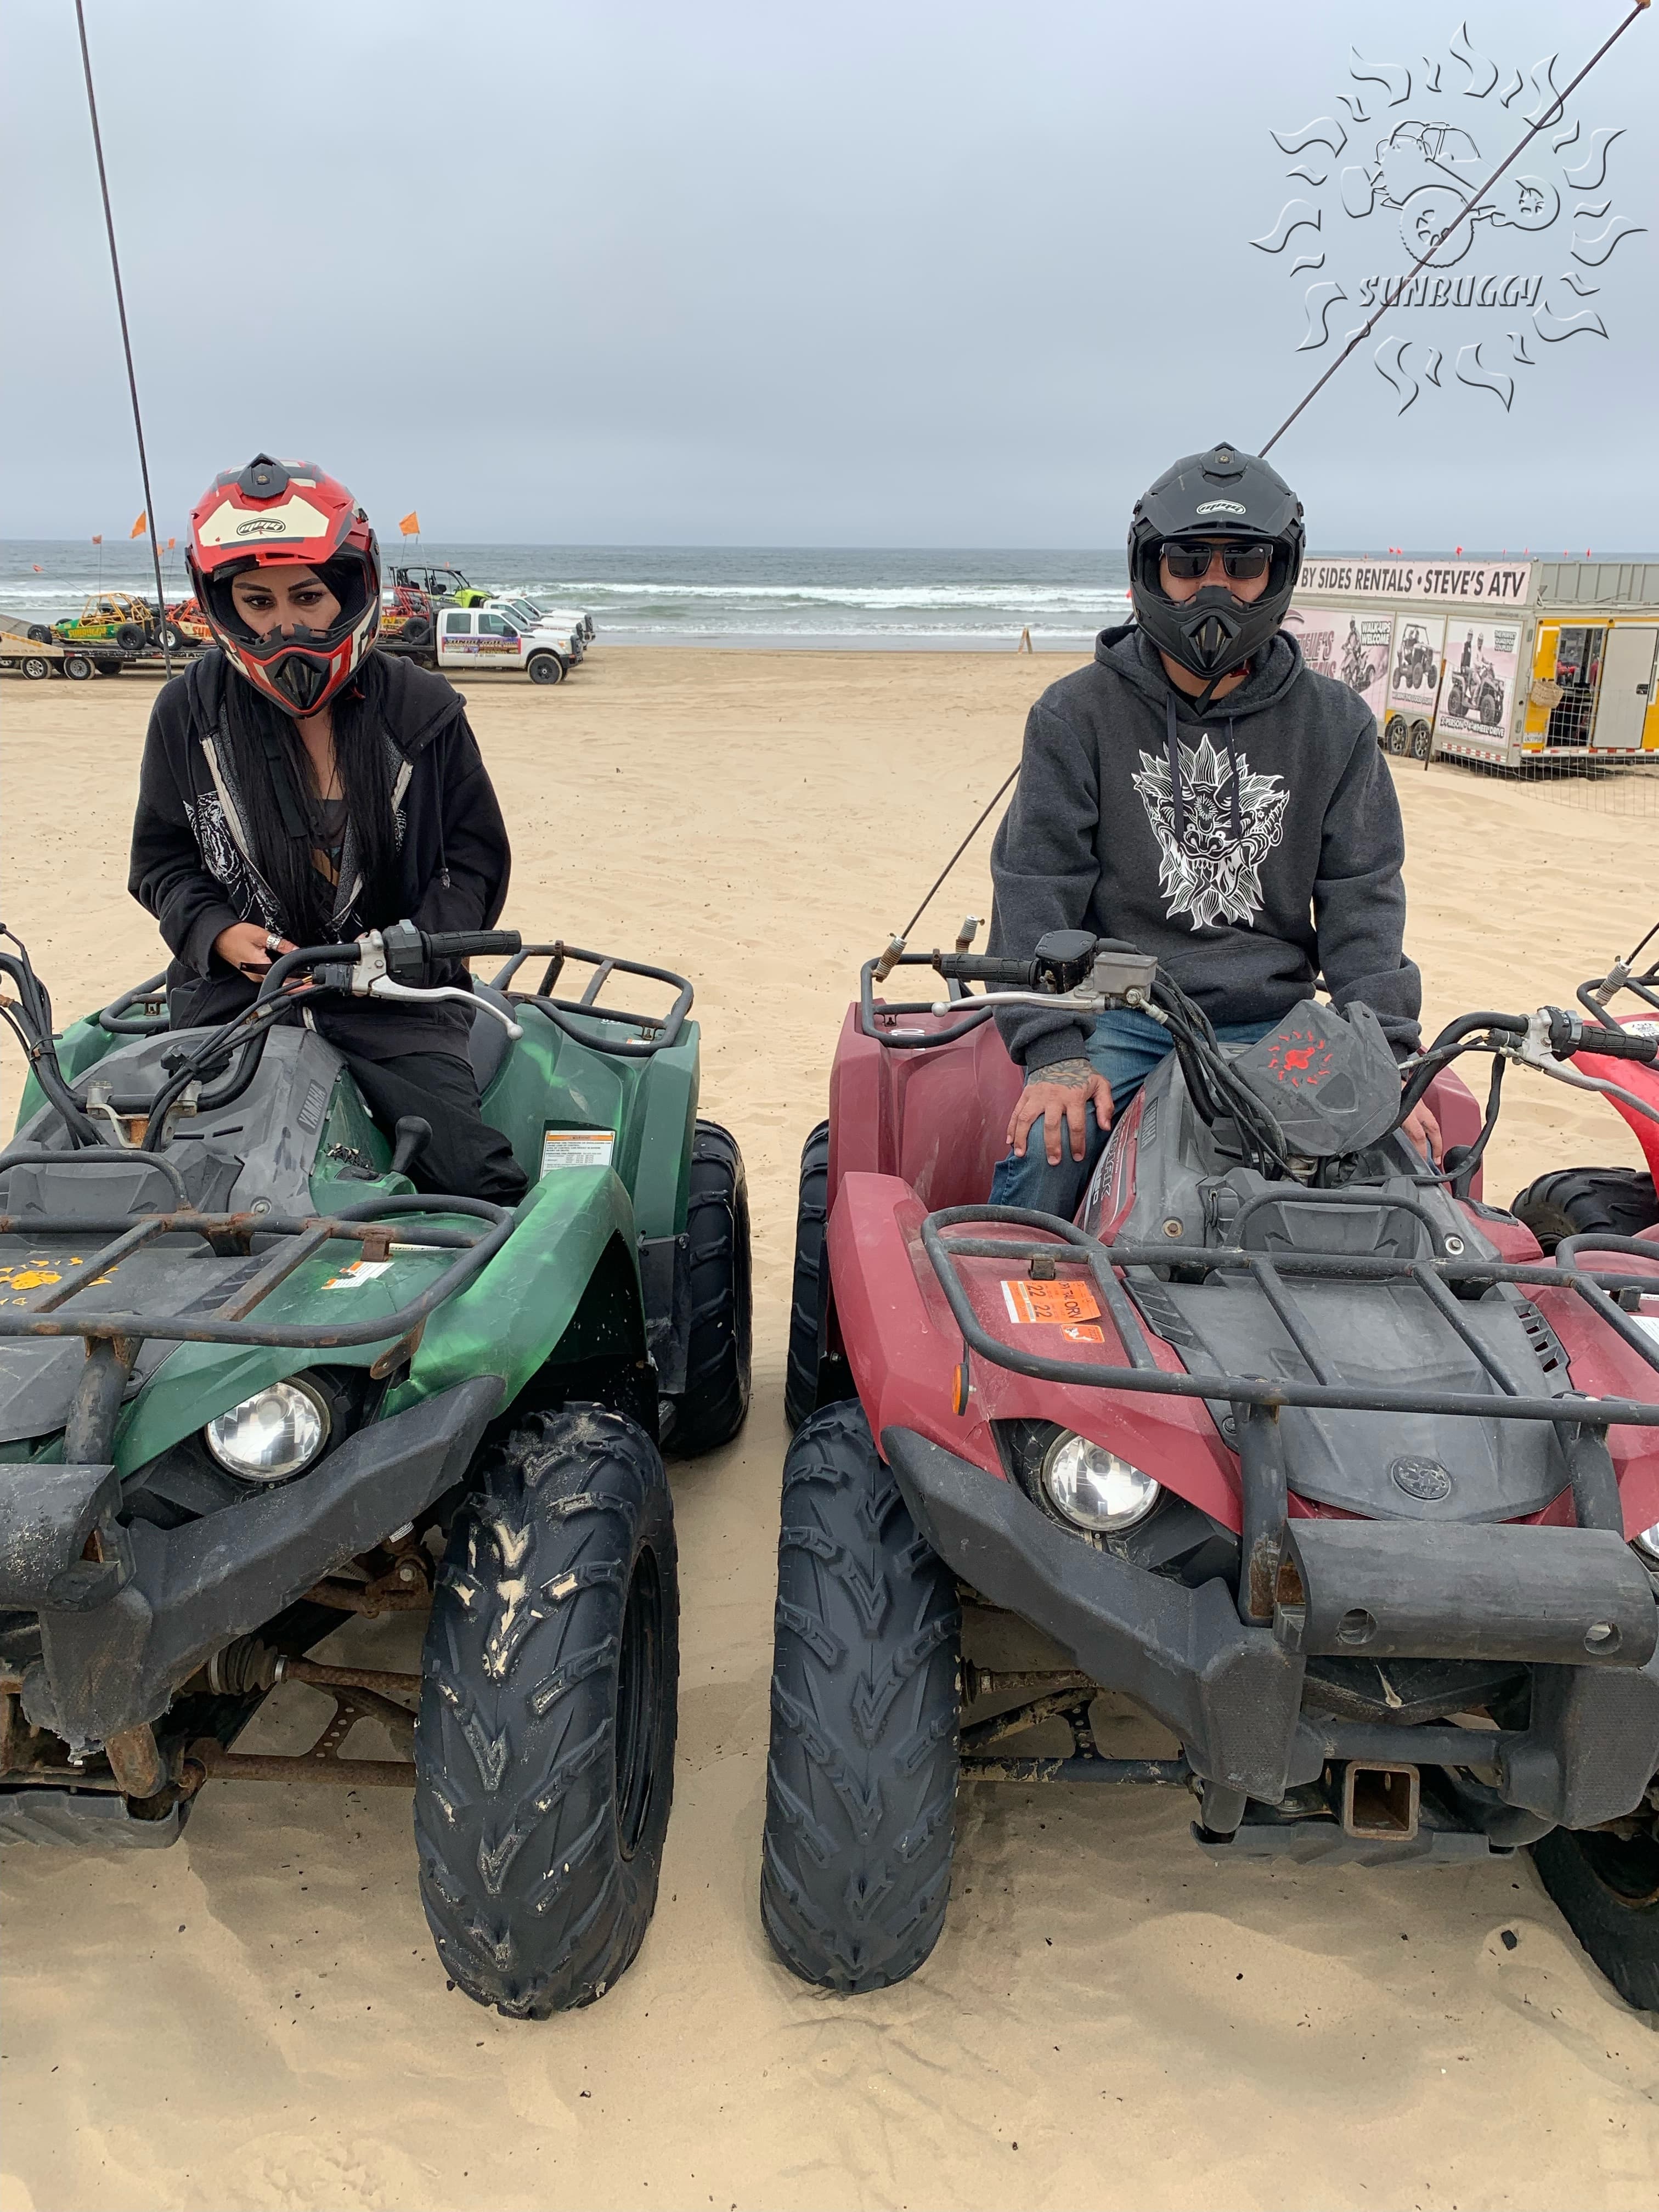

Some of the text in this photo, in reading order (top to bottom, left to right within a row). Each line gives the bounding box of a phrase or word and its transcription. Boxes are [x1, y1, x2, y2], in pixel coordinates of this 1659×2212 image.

[1301, 567, 1526, 597] BY SIDES RENTALS STEVE'S ATV
[1362, 621, 1391, 634] WALK-UPS
[1296, 631, 1334, 659] TEVE'S
[1362, 633, 1390, 646] WELCOME
[1489, 726, 1505, 738] DRIVE
[298, 1083, 325, 1128] YAMAHA
[1141, 1101, 1157, 1149] YAMAHA
[1026, 1285, 1046, 1297] 22
[1034, 1305, 1053, 1318] 22
[1064, 1301, 1084, 1318] ORV
